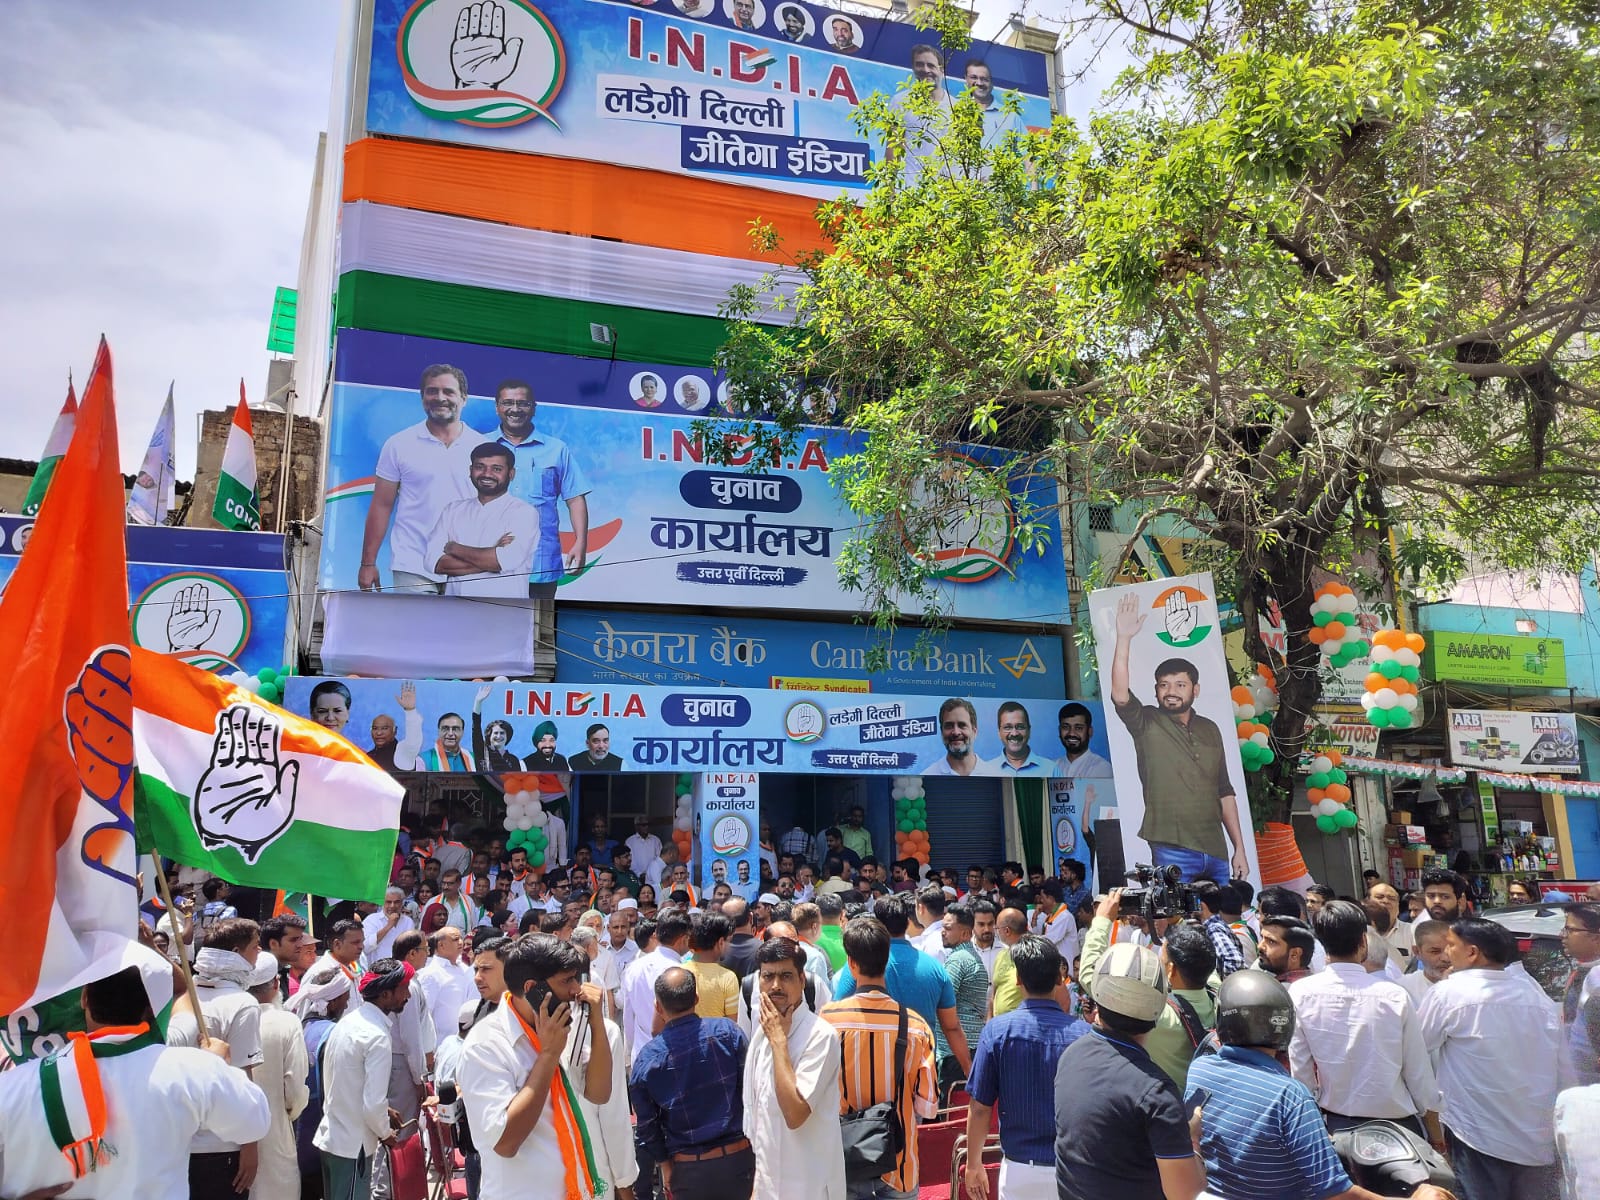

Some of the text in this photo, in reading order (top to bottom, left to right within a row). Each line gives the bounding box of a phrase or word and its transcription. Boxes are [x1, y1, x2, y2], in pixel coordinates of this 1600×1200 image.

[628, 18, 859, 105] I.N.D.I.A
[604, 82, 785, 129] लड़ेगी दिल्ली
[689, 134, 866, 177] जीतेगा इंडिया
[642, 426, 829, 472] I.N.DI.A
[710, 477, 782, 504] चुनाव
[650, 514, 834, 557] कार्यालय
[697, 565, 785, 584] उत्तर पूर्वी दिल्ली
[593, 621, 766, 667] केनरा बैंक
[810, 640, 995, 675] Canra Bank
[1447, 642, 1510, 660] AMARON
[505, 690, 646, 717] I.N.D.I.A
[683, 698, 737, 722] चुनाव
[830, 704, 901, 725] लड़ेगी दिल्ली
[862, 720, 935, 740] जीतेगा इंडिया
[1454, 713, 1480, 726] ARB
[1533, 718, 1558, 729] ARB
[632, 729, 786, 766] कार्यालय
[827, 752, 898, 768] उत्तर पूर्वी दिल्ली
[706, 798, 755, 810] कार्यालय
